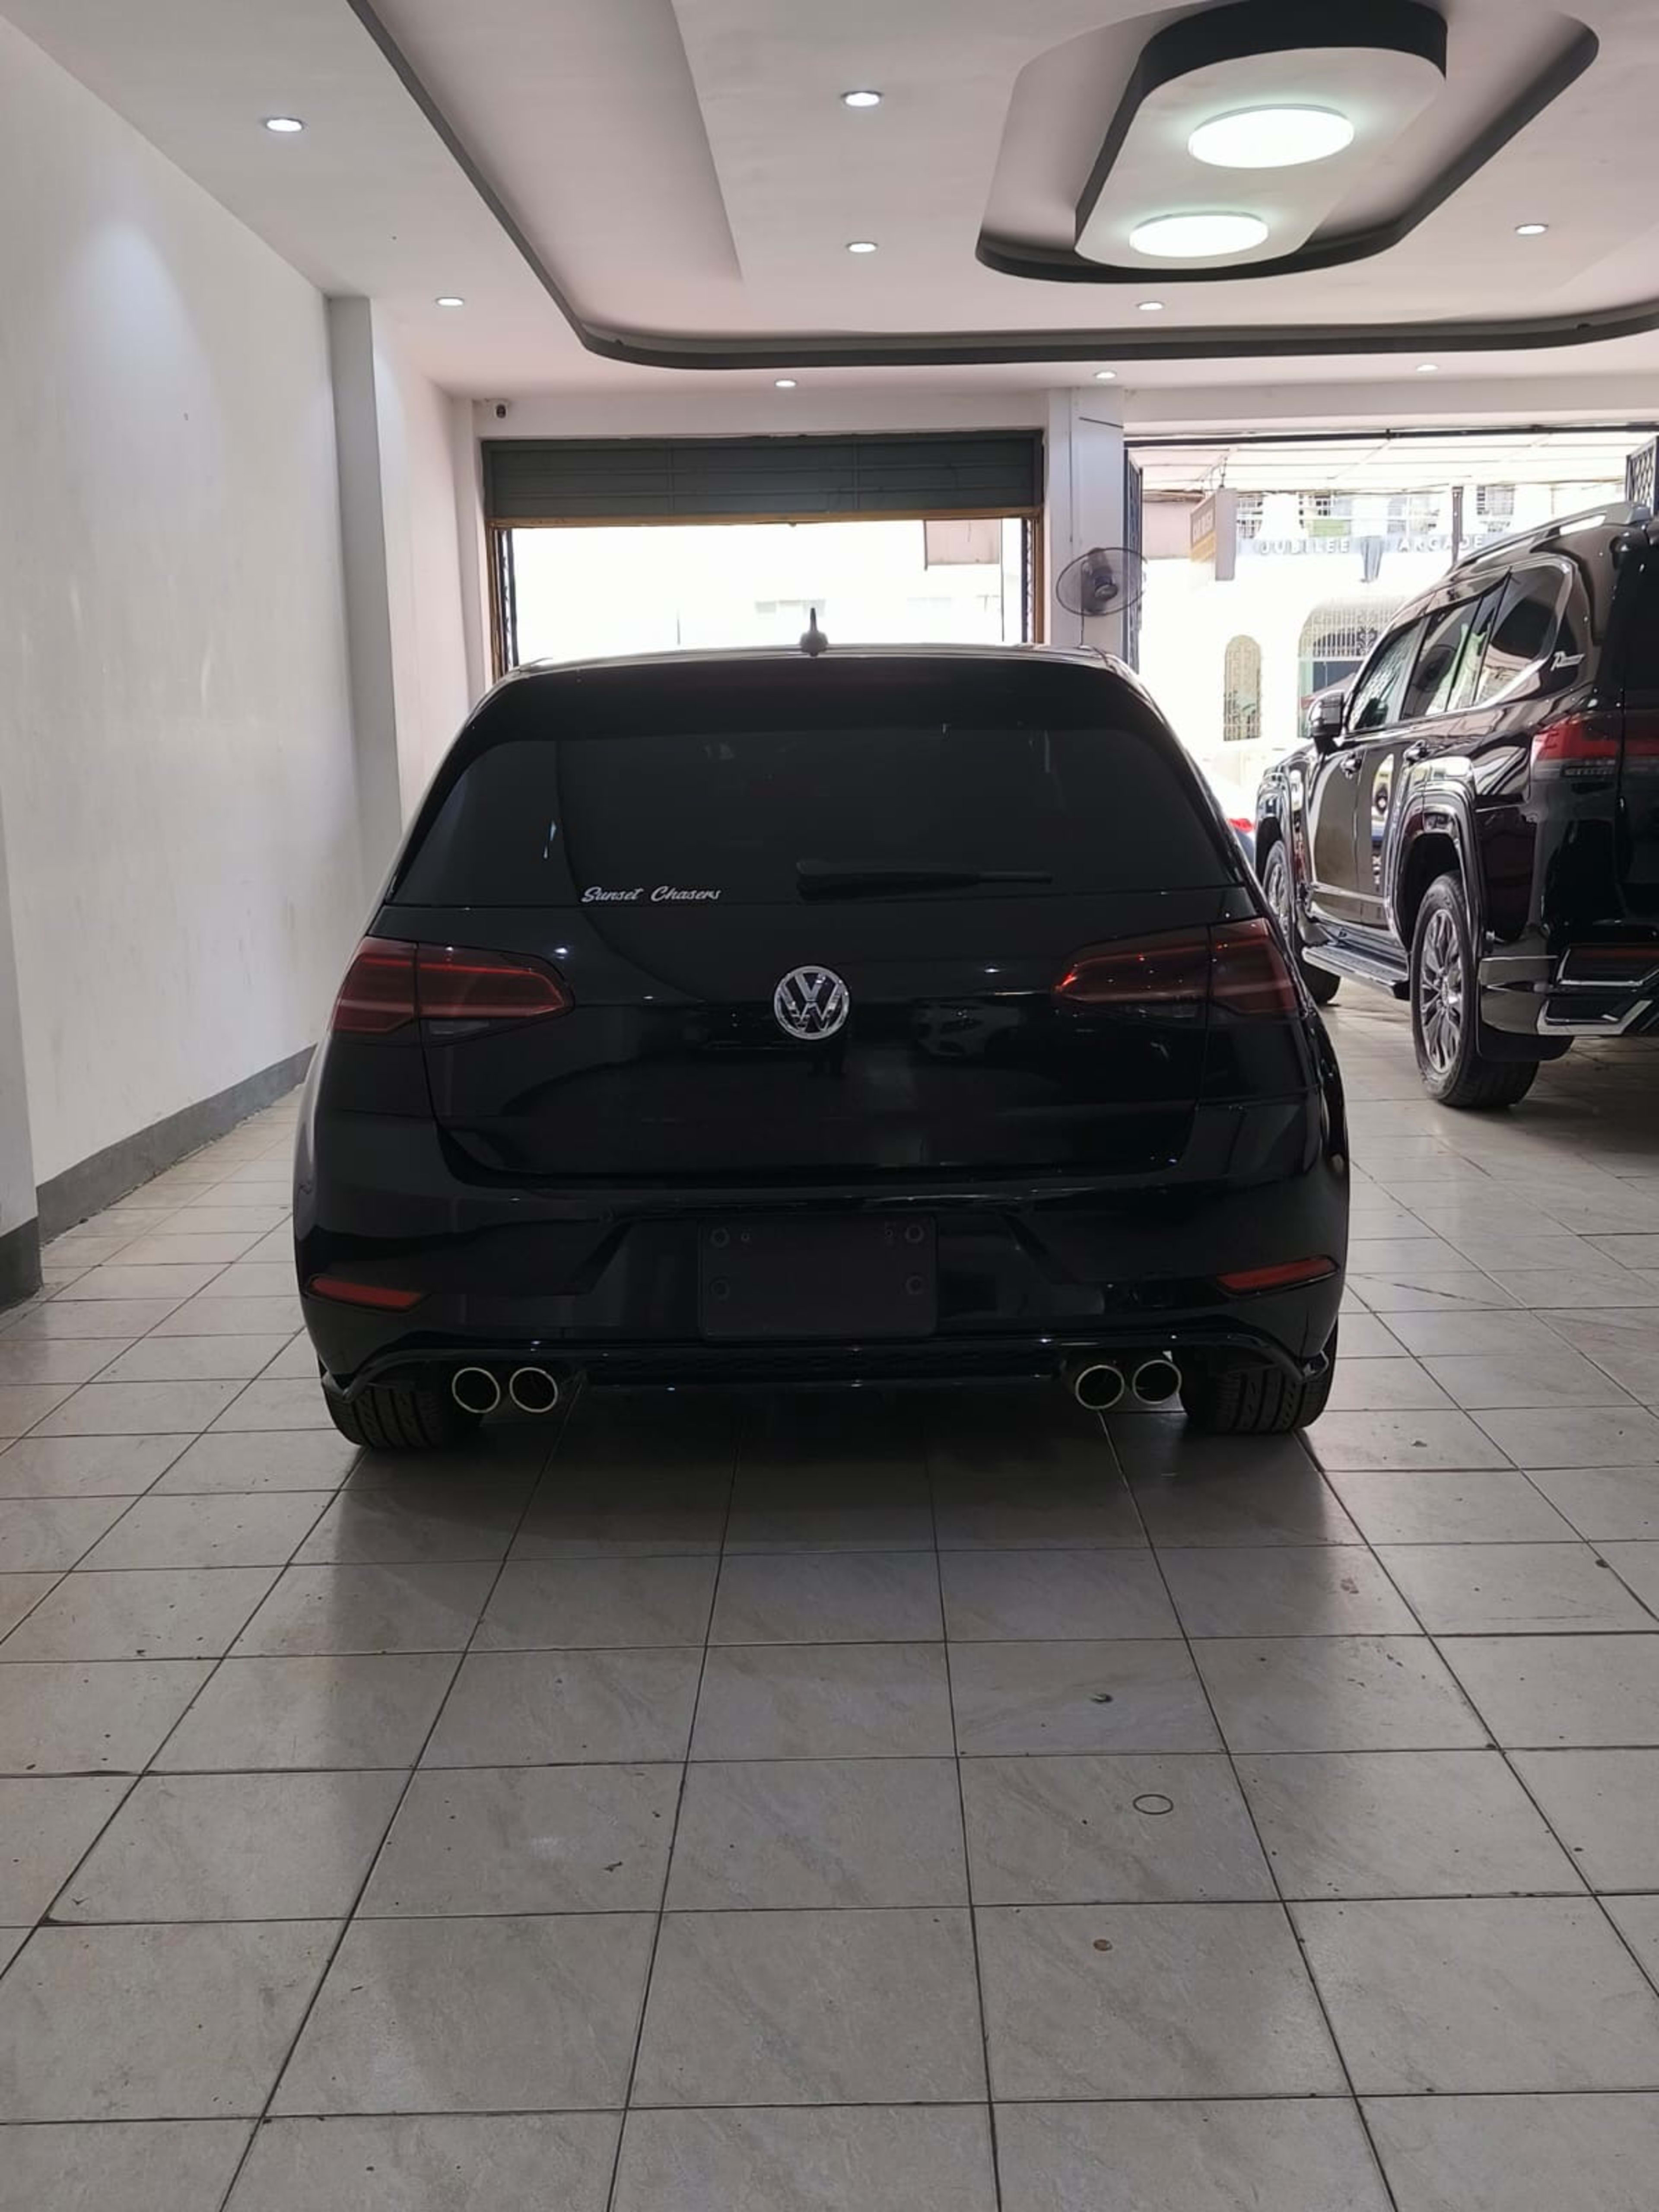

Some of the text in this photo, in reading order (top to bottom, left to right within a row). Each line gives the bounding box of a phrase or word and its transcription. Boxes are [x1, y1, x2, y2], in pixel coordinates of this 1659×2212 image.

[1259, 539, 1350, 555] JUBILEE
[581, 886, 721, 902] Sunset Chasers
